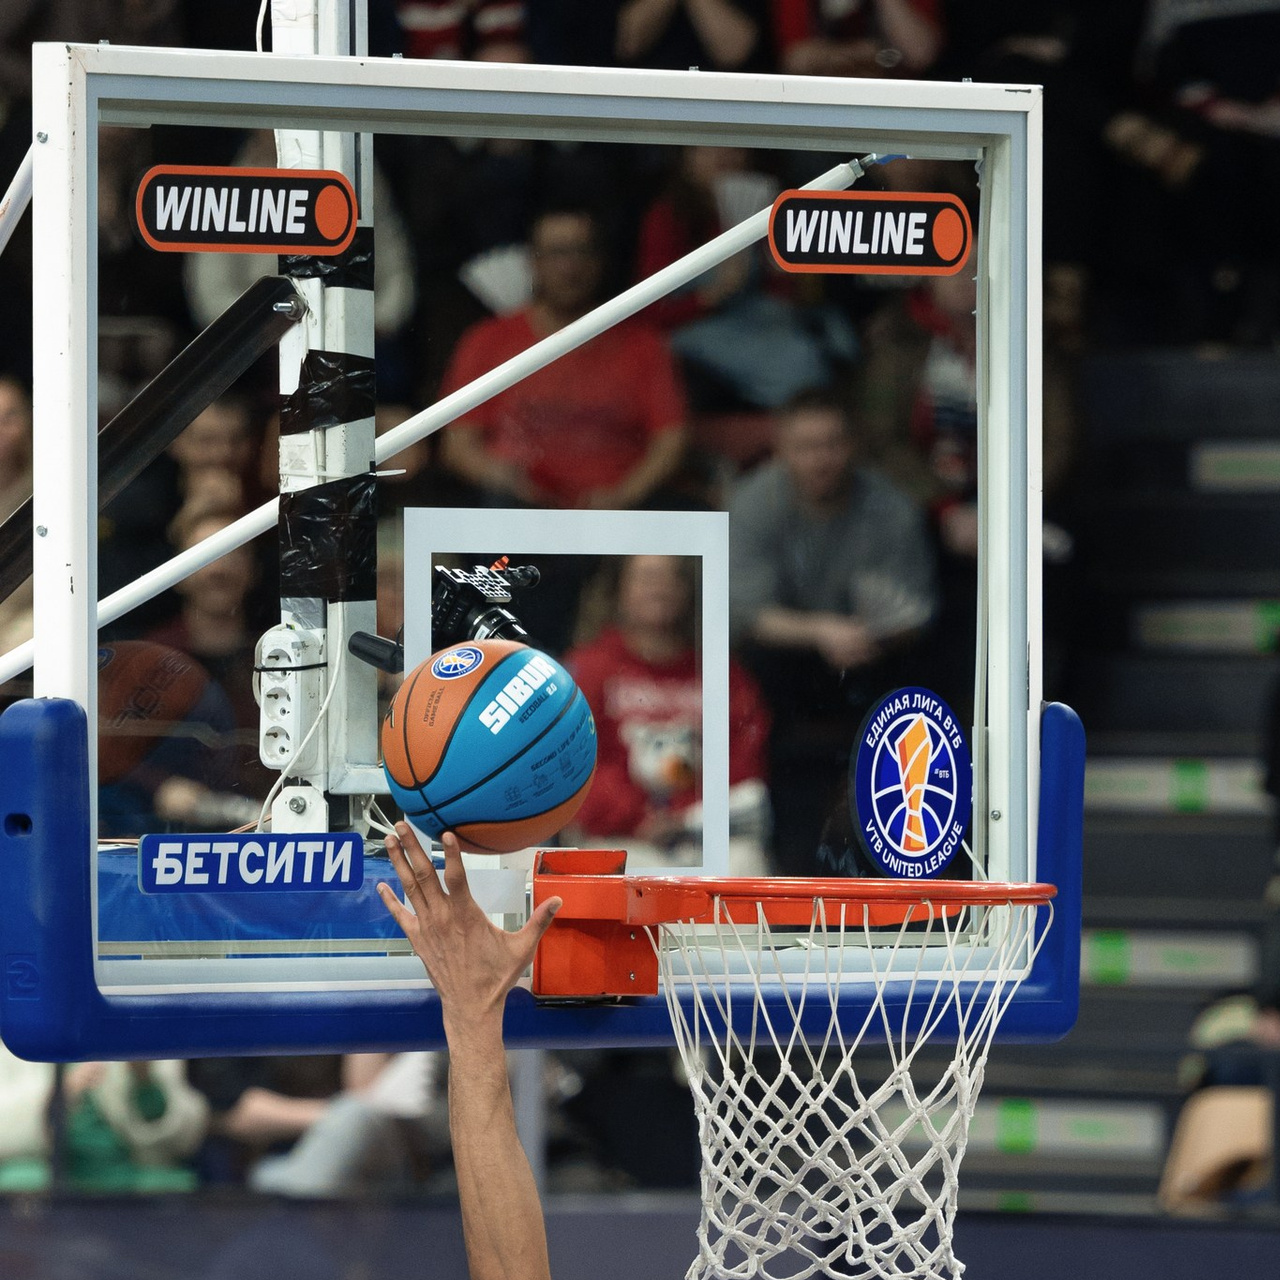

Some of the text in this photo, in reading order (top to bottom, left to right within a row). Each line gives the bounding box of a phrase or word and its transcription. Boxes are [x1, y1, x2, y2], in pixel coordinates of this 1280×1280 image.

[155, 185, 308, 235] WINLINE
[786, 209, 928, 256] WINLINE
[478, 655, 557, 735] SIBUR
[865, 693, 963, 750] ЕДИНАЯ ЛИГА ВТБ
[152, 841, 353, 885] БЕТСИТИ
[865, 819, 963, 878] VTB UNITED LEAGUE
